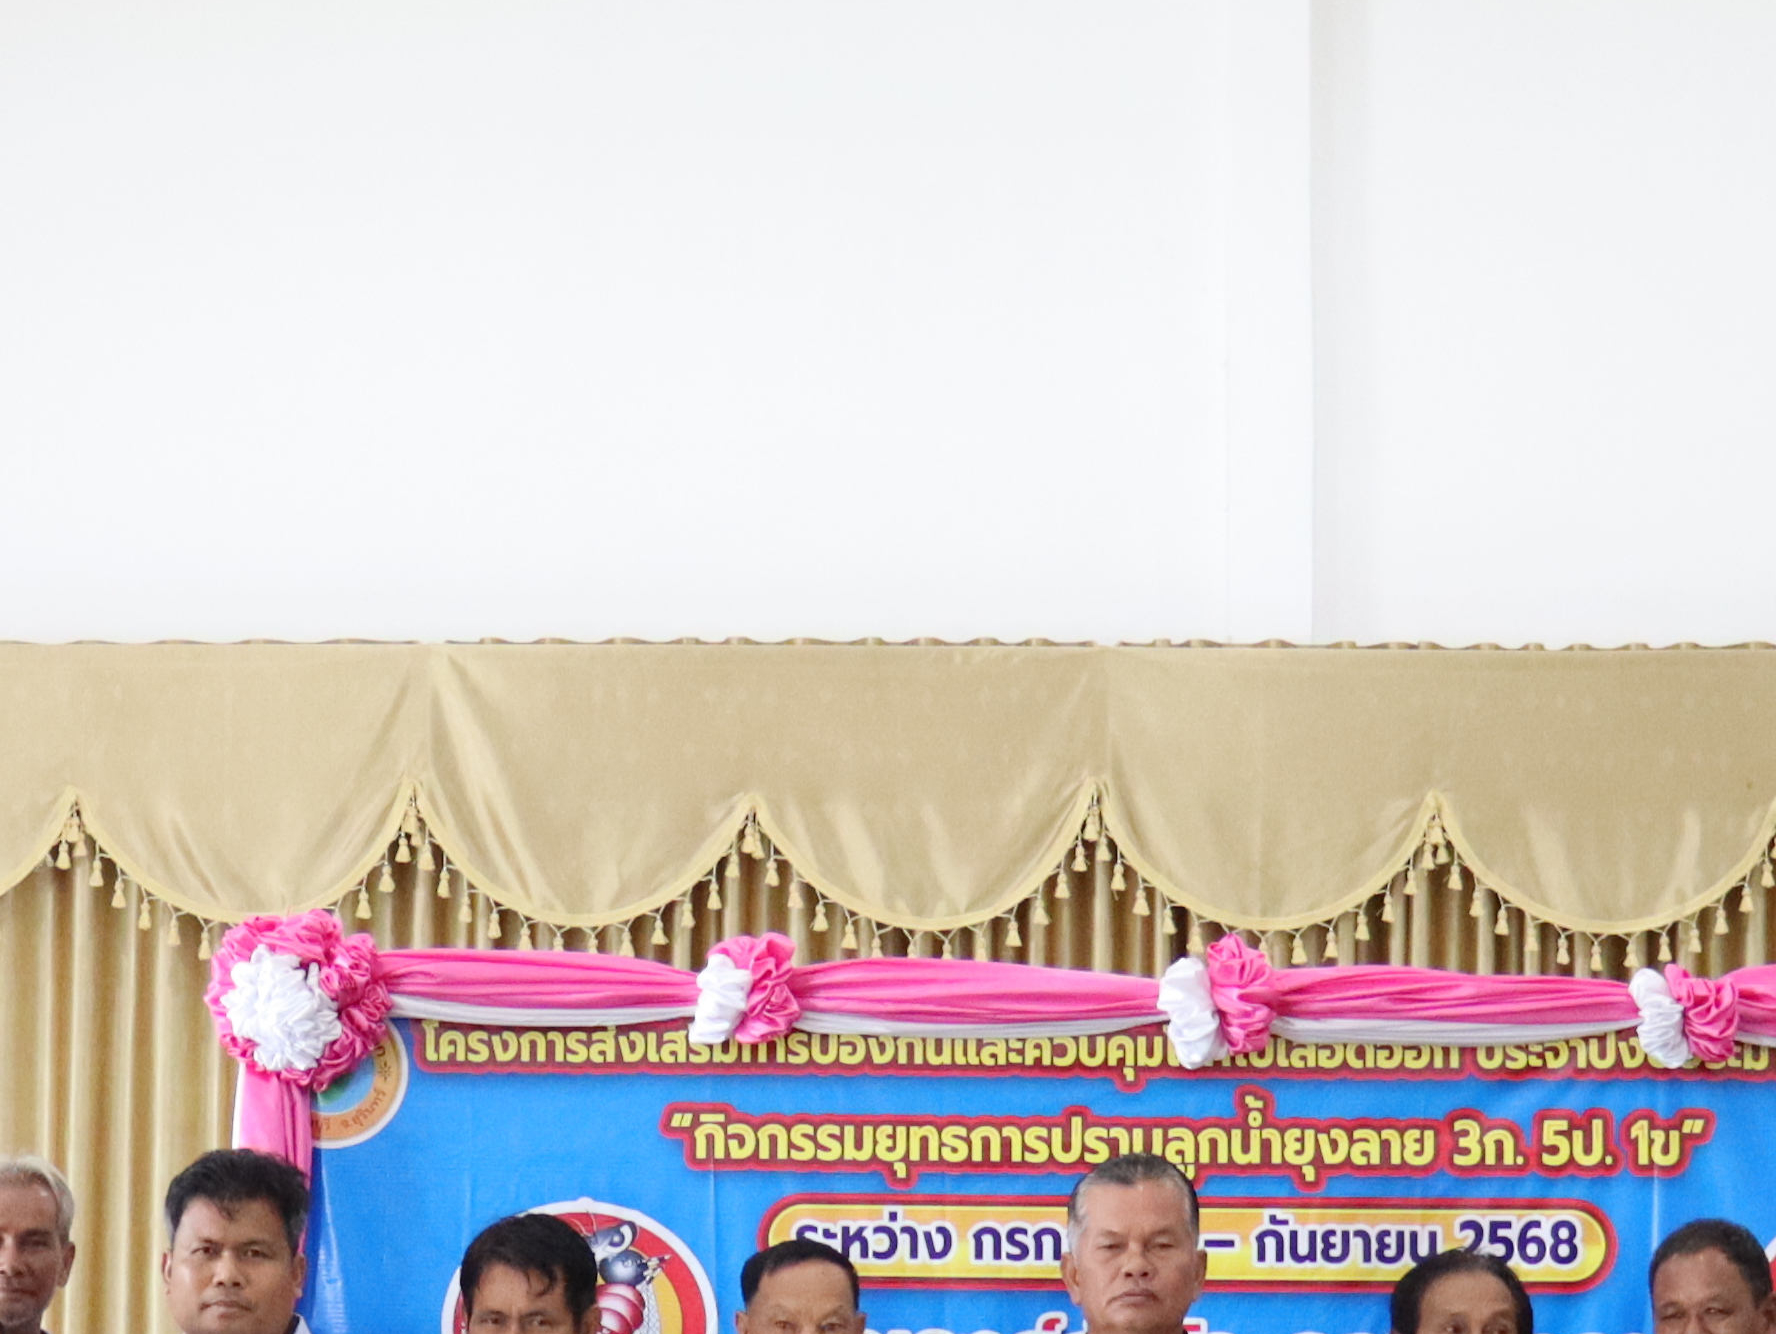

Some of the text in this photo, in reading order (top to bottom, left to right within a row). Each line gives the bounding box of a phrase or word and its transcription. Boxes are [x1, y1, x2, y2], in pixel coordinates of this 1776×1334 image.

[1453, 1119, 1524, 1165] 3ก.
[1542, 1118, 1613, 1165] 5ป.
[1256, 1215, 1438, 1264] กันยายน
[1459, 1220, 1578, 1264] 2568
